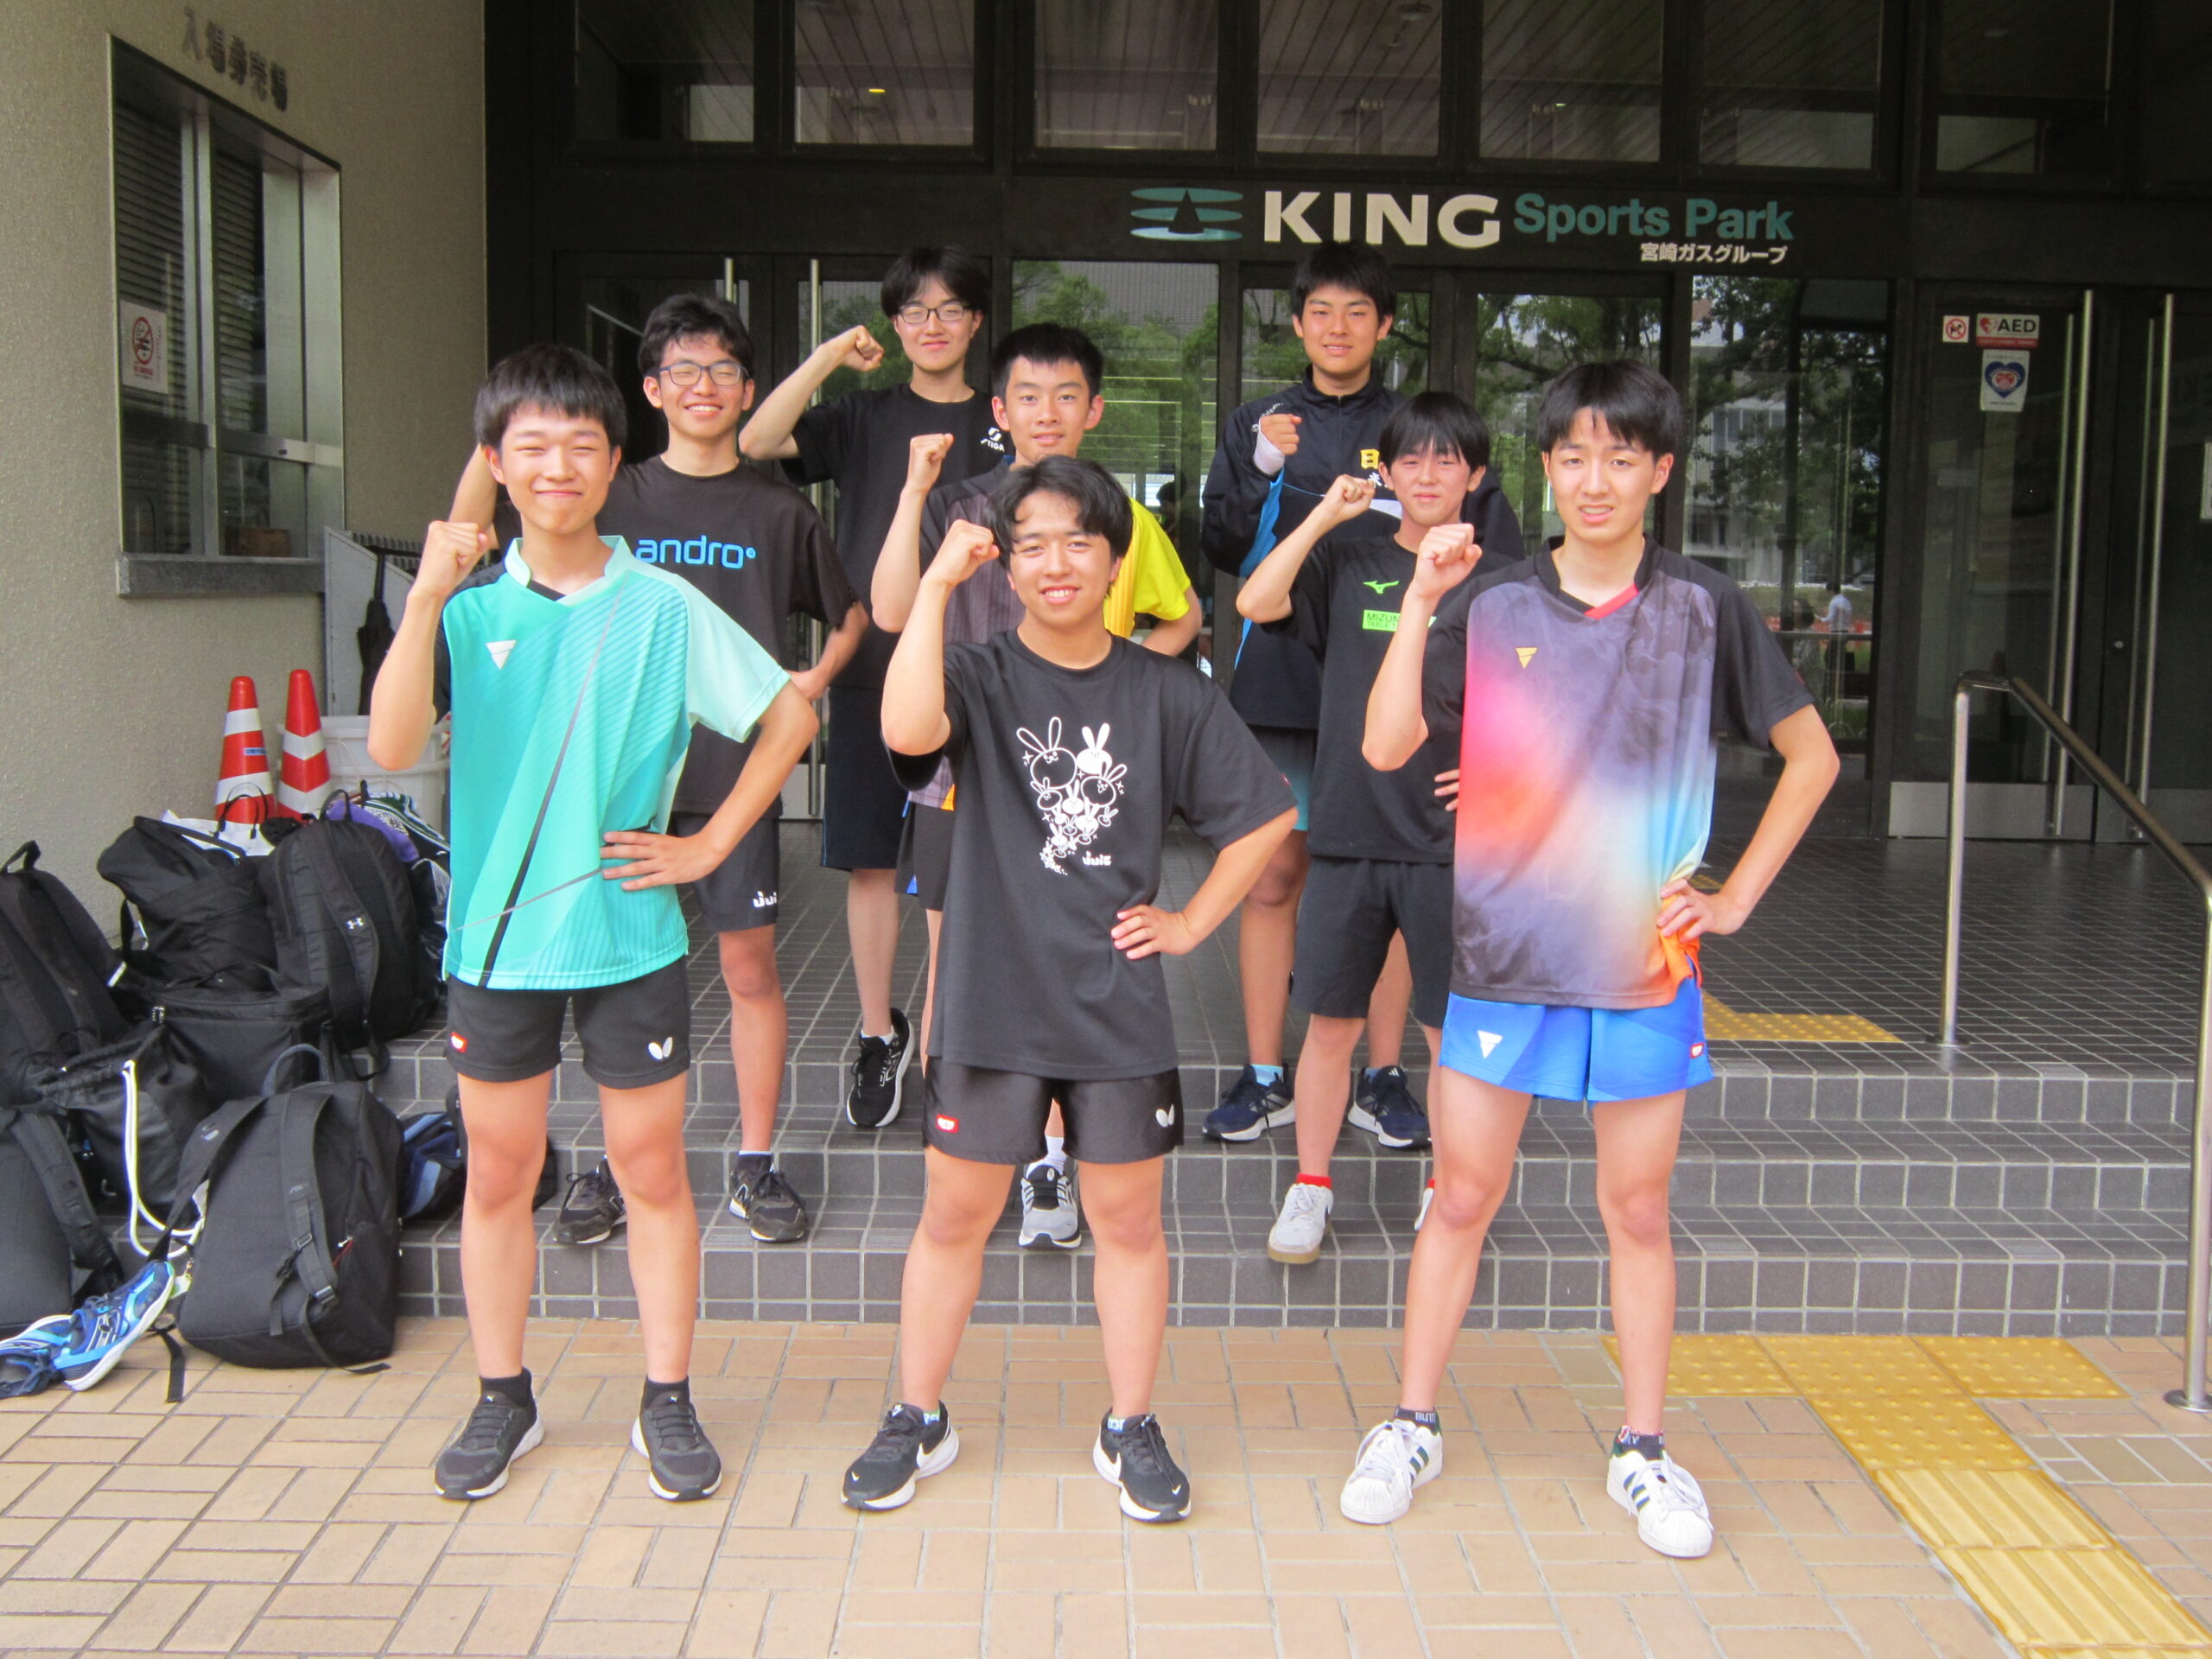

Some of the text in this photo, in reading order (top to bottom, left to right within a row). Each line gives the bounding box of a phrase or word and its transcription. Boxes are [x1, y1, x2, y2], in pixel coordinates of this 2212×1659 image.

[1264, 190, 1794, 249] KING Sports Park
[1641, 242, 1788, 264] 宮崎ガスグループ
[1998, 318, 2037, 333] AED
[1366, 613, 1401, 623] MIZUN
